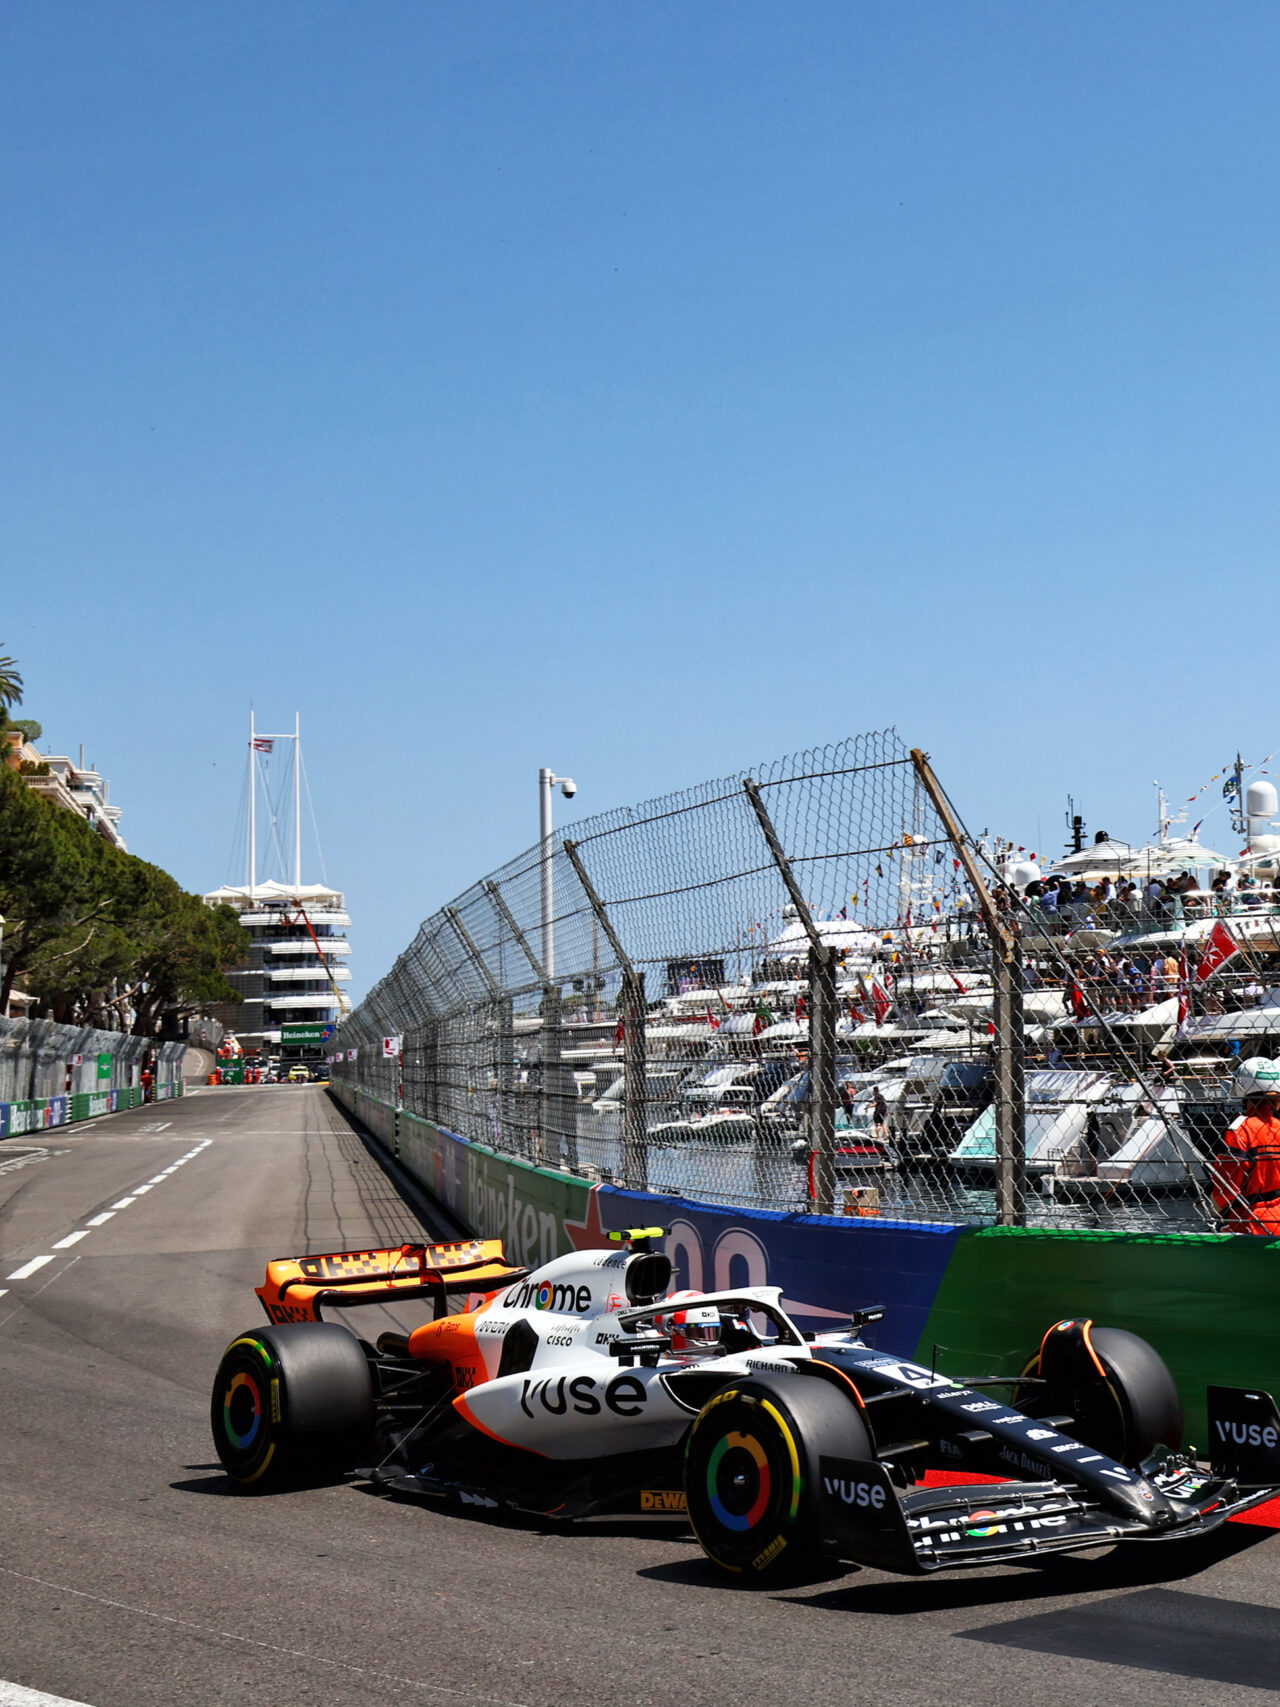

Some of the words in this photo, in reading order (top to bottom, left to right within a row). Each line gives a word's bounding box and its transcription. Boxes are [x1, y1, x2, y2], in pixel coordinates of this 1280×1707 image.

[283, 1031, 321, 1040] Heineken
[468, 1152, 558, 1270] Heineken
[503, 1277, 592, 1313] Chrome
[546, 1335, 573, 1347] CISCO
[745, 1359, 788, 1374] RICHARD
[897, 1365, 940, 1382] 4
[520, 1375, 648, 1419] vuse
[960, 1401, 999, 1411] DELL
[1215, 1419, 1279, 1448] vuse
[640, 1491, 687, 1509] DEWA
[823, 1476, 887, 1509] vuse
